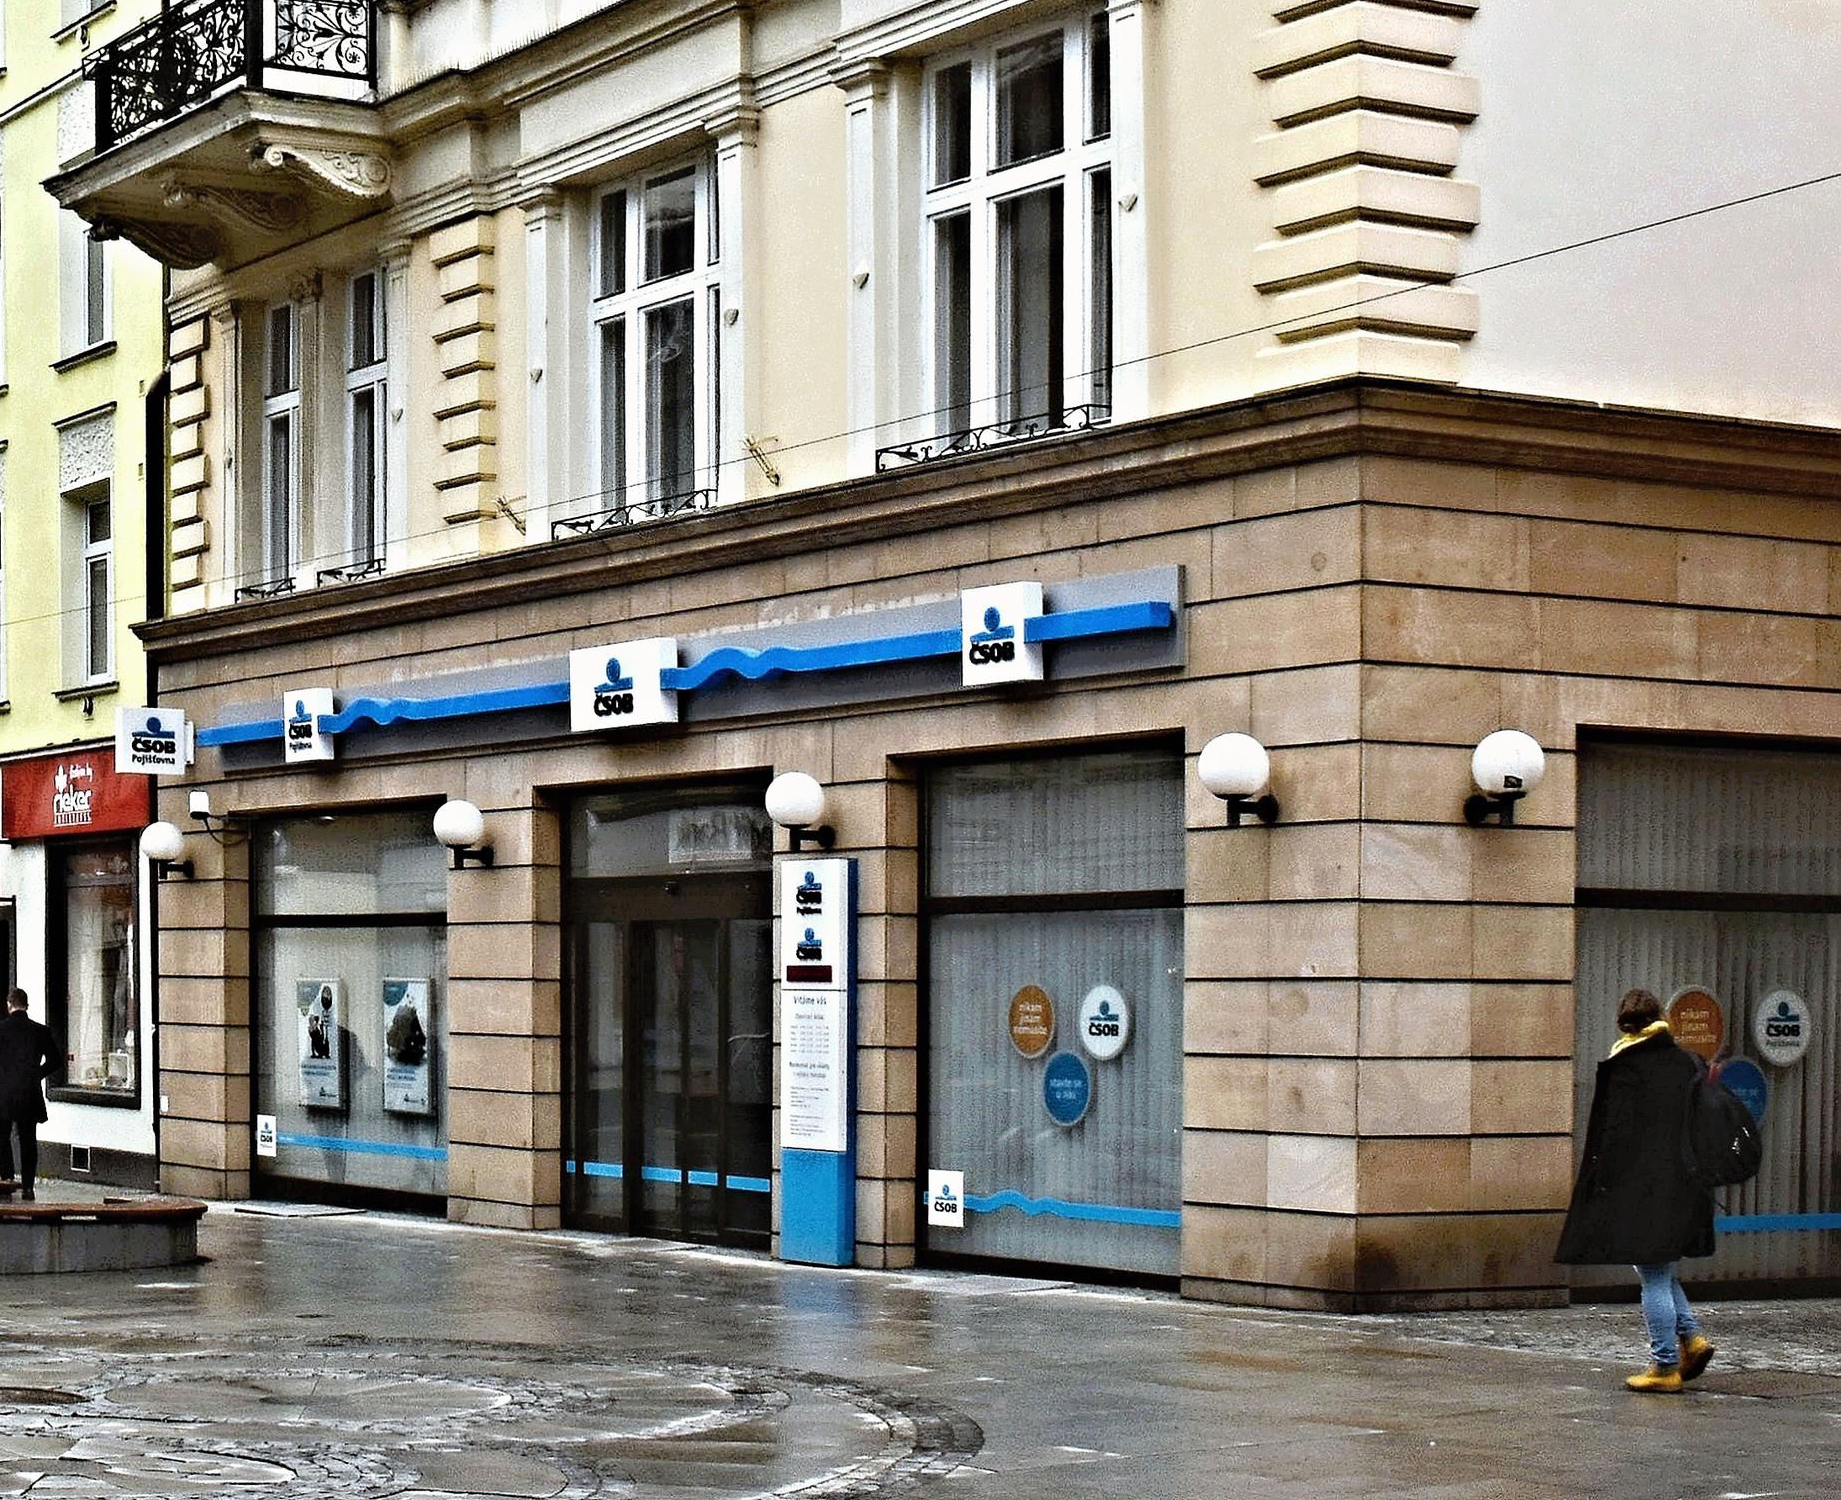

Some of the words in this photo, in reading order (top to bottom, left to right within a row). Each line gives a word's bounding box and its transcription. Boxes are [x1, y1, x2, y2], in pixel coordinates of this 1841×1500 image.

[969, 641, 1016, 665] ČSOB
[593, 692, 634, 717] ČSOB
[131, 737, 177, 754] ČSOB
[53, 783, 92, 814] rieker
[1088, 1022, 1119, 1037] ČSOB
[1766, 1023, 1801, 1037] ČSOB
[934, 1201, 958, 1214] ČSOB
